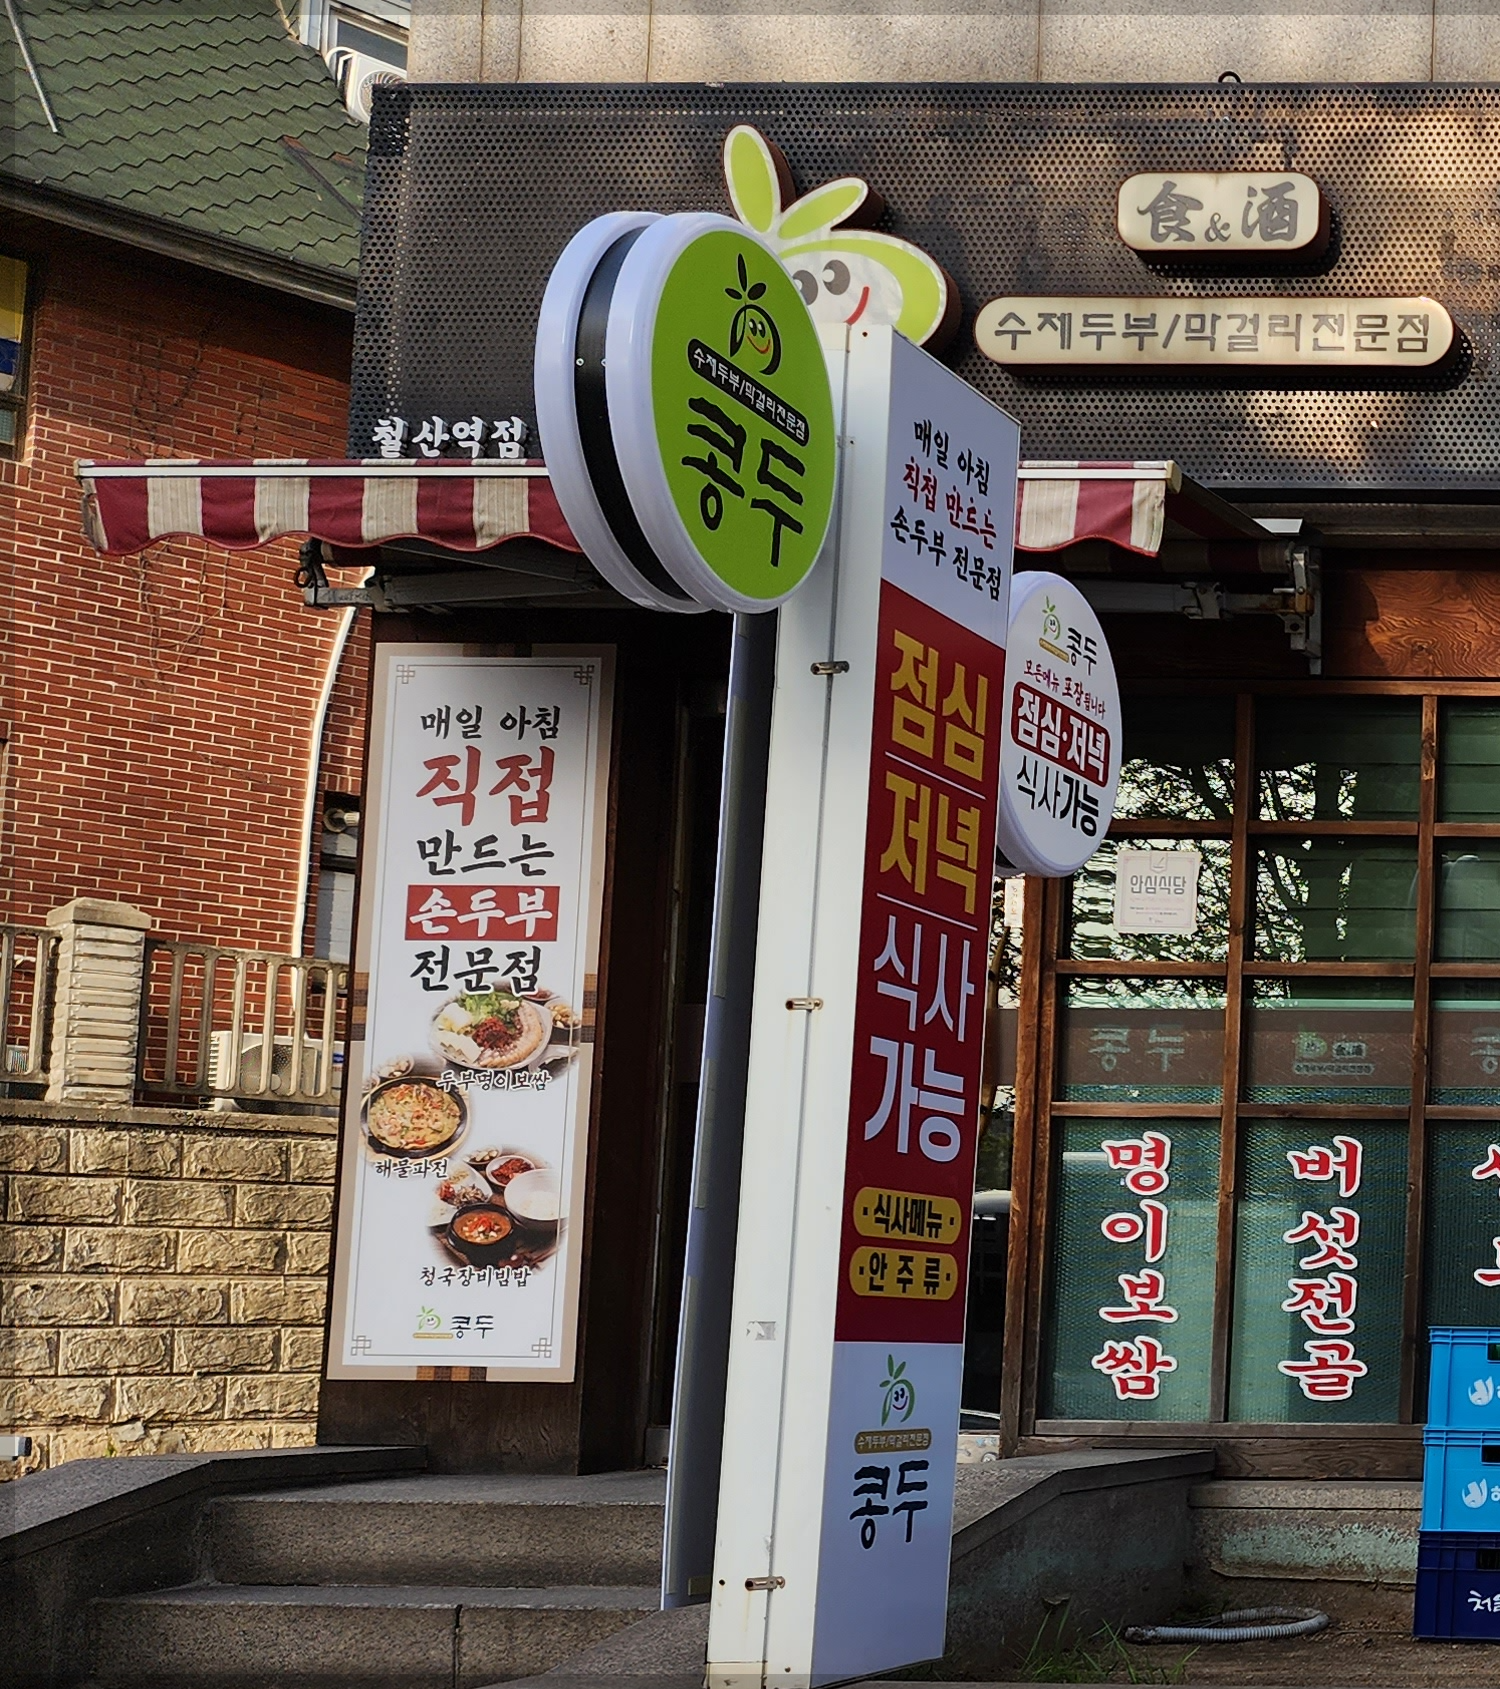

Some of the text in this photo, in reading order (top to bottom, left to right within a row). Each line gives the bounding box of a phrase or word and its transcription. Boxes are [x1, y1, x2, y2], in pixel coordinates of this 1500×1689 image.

[994, 311, 1431, 354] 수제두부/막걸리전문점
[692, 347, 806, 441] 수제두부/막걸리전문점
[371, 416, 528, 459] 철산역점
[914, 418, 990, 497] 매일 아침
[681, 396, 806, 568] 콩두
[903, 455, 997, 551] 직접 만드는
[890, 504, 1002, 602] 손두부 전문점
[1066, 627, 1098, 677] 콩두
[420, 704, 561, 741] 매일 아침
[890, 627, 989, 783] 점심
[1023, 658, 1107, 721] 모든메뉴 포장됩니다
[415, 745, 556, 827] 직접
[1016, 754, 1100, 838] 식사가능
[416, 828, 556, 877] 만드는
[879, 770, 981, 916] 저녁
[409, 886, 554, 938] 손두부
[1130, 874, 1187, 896] 안심식당
[409, 943, 543, 995] 전문점
[873, 912, 975, 1044] 식사
[435, 1069, 552, 1092] 두부명이보쌈
[863, 1033, 967, 1165] 가능
[374, 1157, 450, 1180] 해물파전
[873, 1192, 944, 1240] 식사메뉴
[419, 1265, 532, 1288] 청국장비빔밥
[1092, 1131, 1179, 1400] 명이보쌈
[1278, 1135, 1368, 1401] 버섯전골
[450, 1315, 494, 1339] 콩두
[849, 1459, 930, 1550] 콩두
